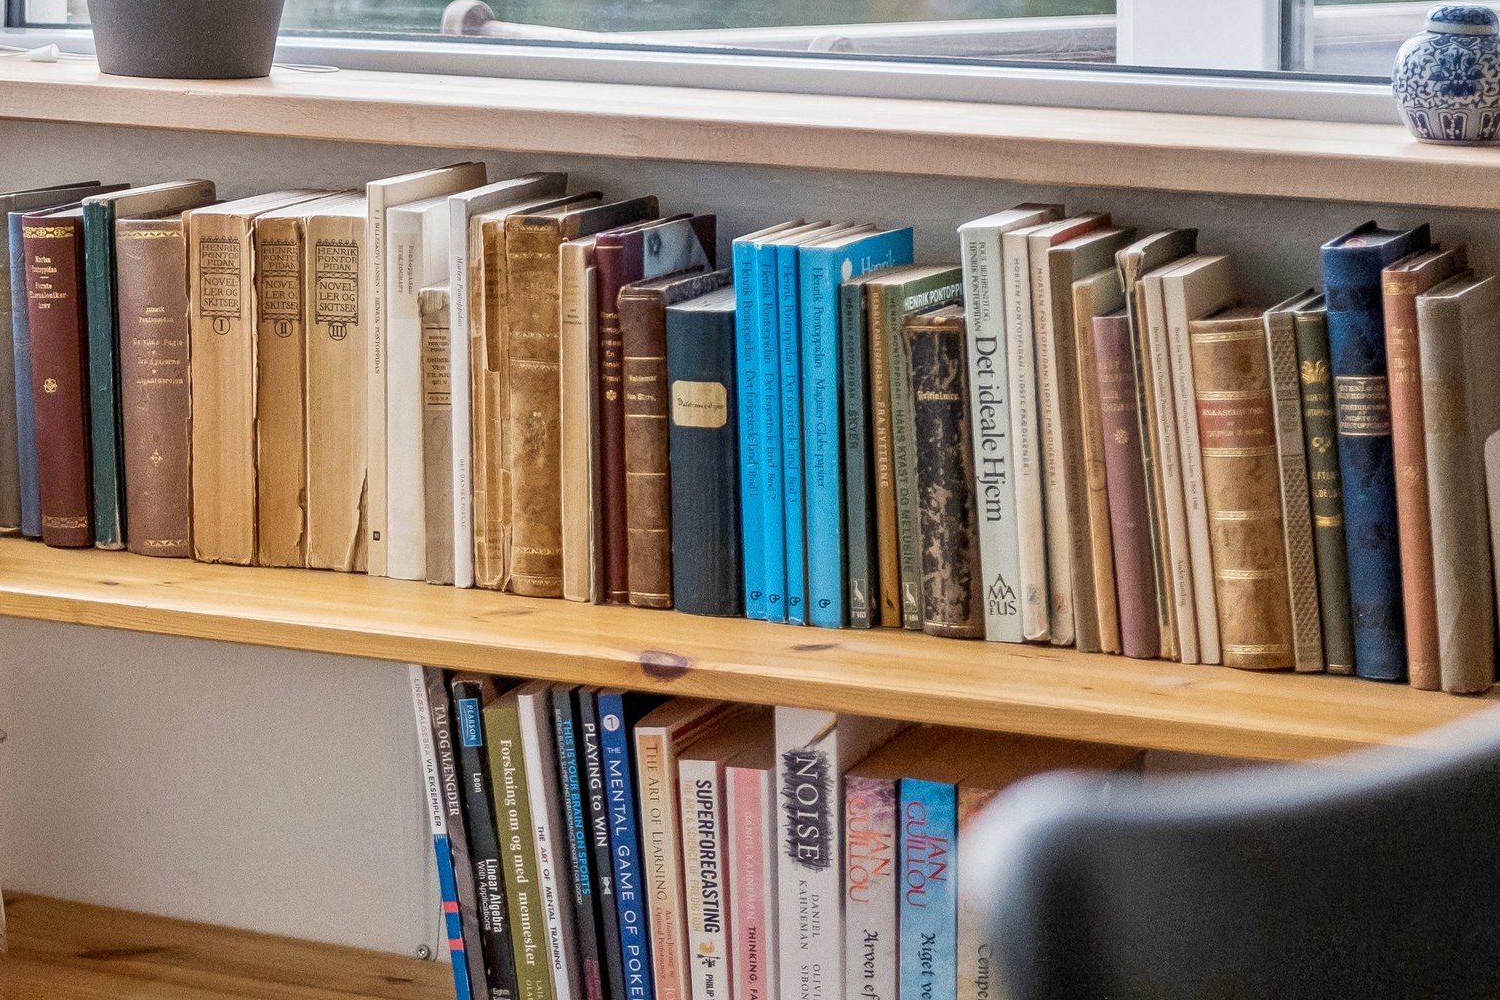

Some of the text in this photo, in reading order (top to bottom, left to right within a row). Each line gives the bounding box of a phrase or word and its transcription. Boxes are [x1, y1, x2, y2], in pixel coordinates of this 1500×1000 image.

[202, 244, 239, 252] HENRIK
[317, 248, 356, 256] HENRIK
[204, 288, 238, 296] LER OG
[265, 291, 284, 299] LER
[319, 293, 355, 301] LER OG
[456, 256, 464, 327] Morten Pontoppidan
[742, 262, 753, 295] Henrik
[762, 264, 773, 298] Henrik
[783, 265, 794, 300] Henrik
[813, 267, 824, 302] Henrik
[969, 242, 982, 332] HENRIK PONTOPPIDAN
[1013, 257, 1022, 295] MORTEN
[1036, 267, 1045, 307] MORTEN
[204, 299, 239, 307] SKITSER
[319, 304, 356, 312] SKITSER
[905, 294, 929, 310] HENRIK
[742, 301, 757, 361] Pontoppidan
[762, 303, 775, 364] Pontoppidan
[782, 305, 796, 365] Pontoppidan
[812, 306, 826, 368] Pontoppidan
[745, 370, 756, 389] Det
[765, 373, 775, 391] Det
[786, 375, 796, 392] Det
[848, 409, 860, 449] SKYER
[877, 402, 889, 487] FRA HYTTERNE
[975, 335, 1007, 522] Det ideale Hjem
[895, 409, 913, 572] HANS KVAST OG MELUSINE
[467, 704, 476, 741] PEARSON
[414, 678, 442, 827] LINEÆR ALGEBRA VIA EKSEMPLER
[434, 704, 459, 816] TAL OG MÆNGDER
[606, 746, 621, 754] THE
[473, 772, 482, 793] Leon
[584, 723, 608, 847] PLAYING to WIN
[563, 719, 591, 895] THIS IS YOUR BRAIN ON SPORTS
[646, 743, 667, 901] THE ART OF LEARNING
[796, 757, 819, 860] NOISE
[501, 739, 537, 966] Forskning om og med mennesker
[540, 847, 548, 864] ART
[608, 760, 638, 936] MENTAL GAME OF
[696, 779, 720, 933] SUPERFORECASTING
[848, 798, 869, 904] GUILLOU
[867, 829, 891, 876] JAN
[906, 801, 926, 908] GUILLOU
[925, 833, 948, 881] JAN
[478, 861, 491, 931] With Applications
[486, 859, 502, 933] Linear Algebra
[543, 868, 550, 881] OF
[545, 886, 556, 921] MENTAL
[665, 909, 672, 920] An
[799, 879, 808, 950] KAHNEMAN
[812, 894, 820, 937] DANIEL
[550, 926, 562, 970] TRAINING
[748, 927, 758, 984] THINKING,
[863, 929, 878, 979] Arven
[918, 932, 936, 976] Riget
[705, 973, 714, 997] PHILIP
